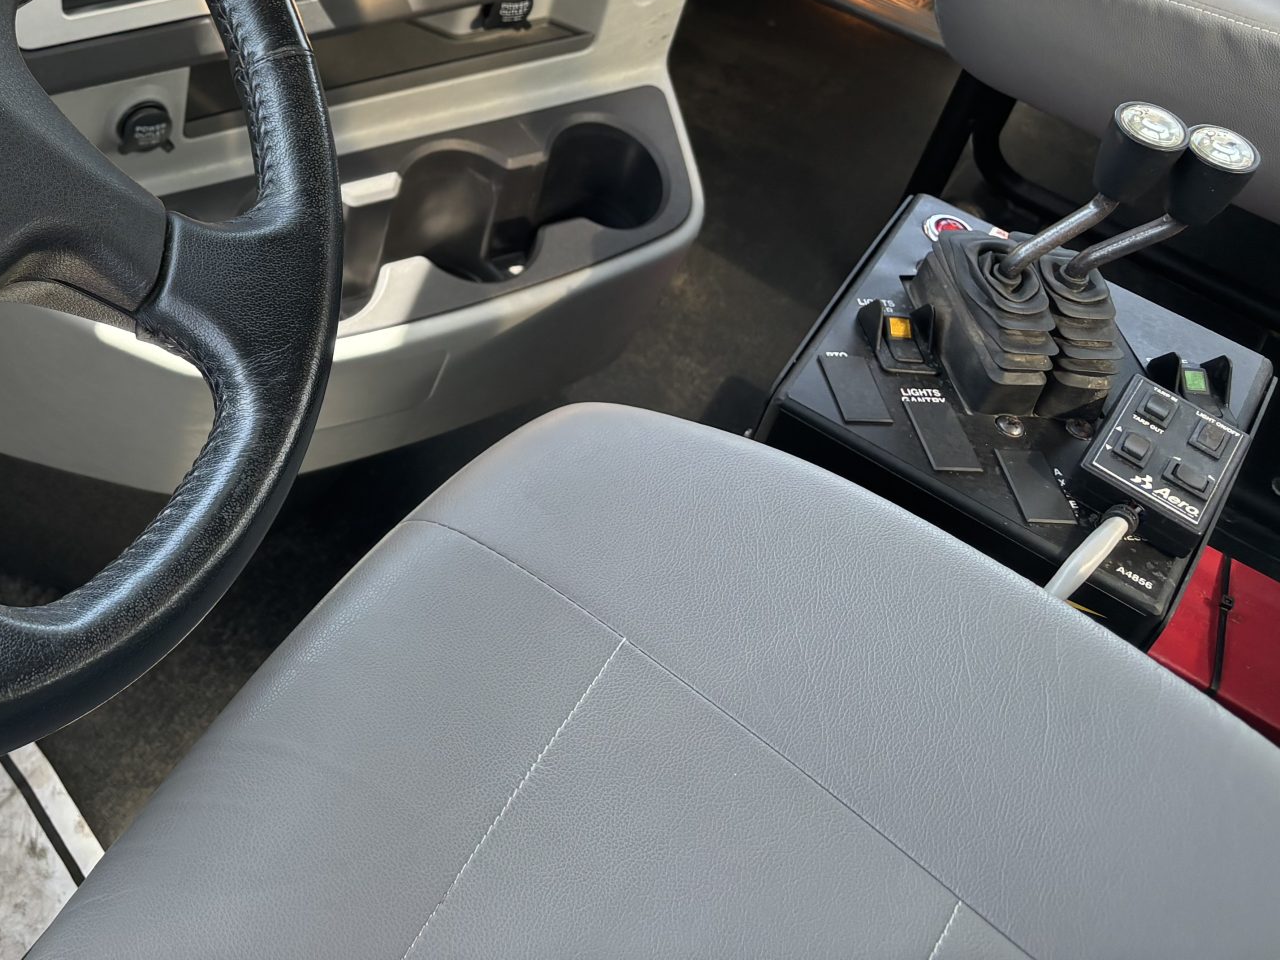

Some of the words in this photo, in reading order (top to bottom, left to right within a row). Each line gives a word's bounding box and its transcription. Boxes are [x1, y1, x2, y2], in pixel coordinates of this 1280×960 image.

[857, 298, 895, 308] LITS
[900, 388, 941, 397] LIGHTS
[1153, 386, 1171, 398] TARP
[1132, 414, 1150, 426] TARP
[1149, 423, 1165, 435] OUT
[1195, 410, 1216, 424] LIGHT
[1215, 420, 1241, 437] ON/OFF
[1156, 487, 1201, 516] Aero
[1116, 566, 1153, 590] A4856
